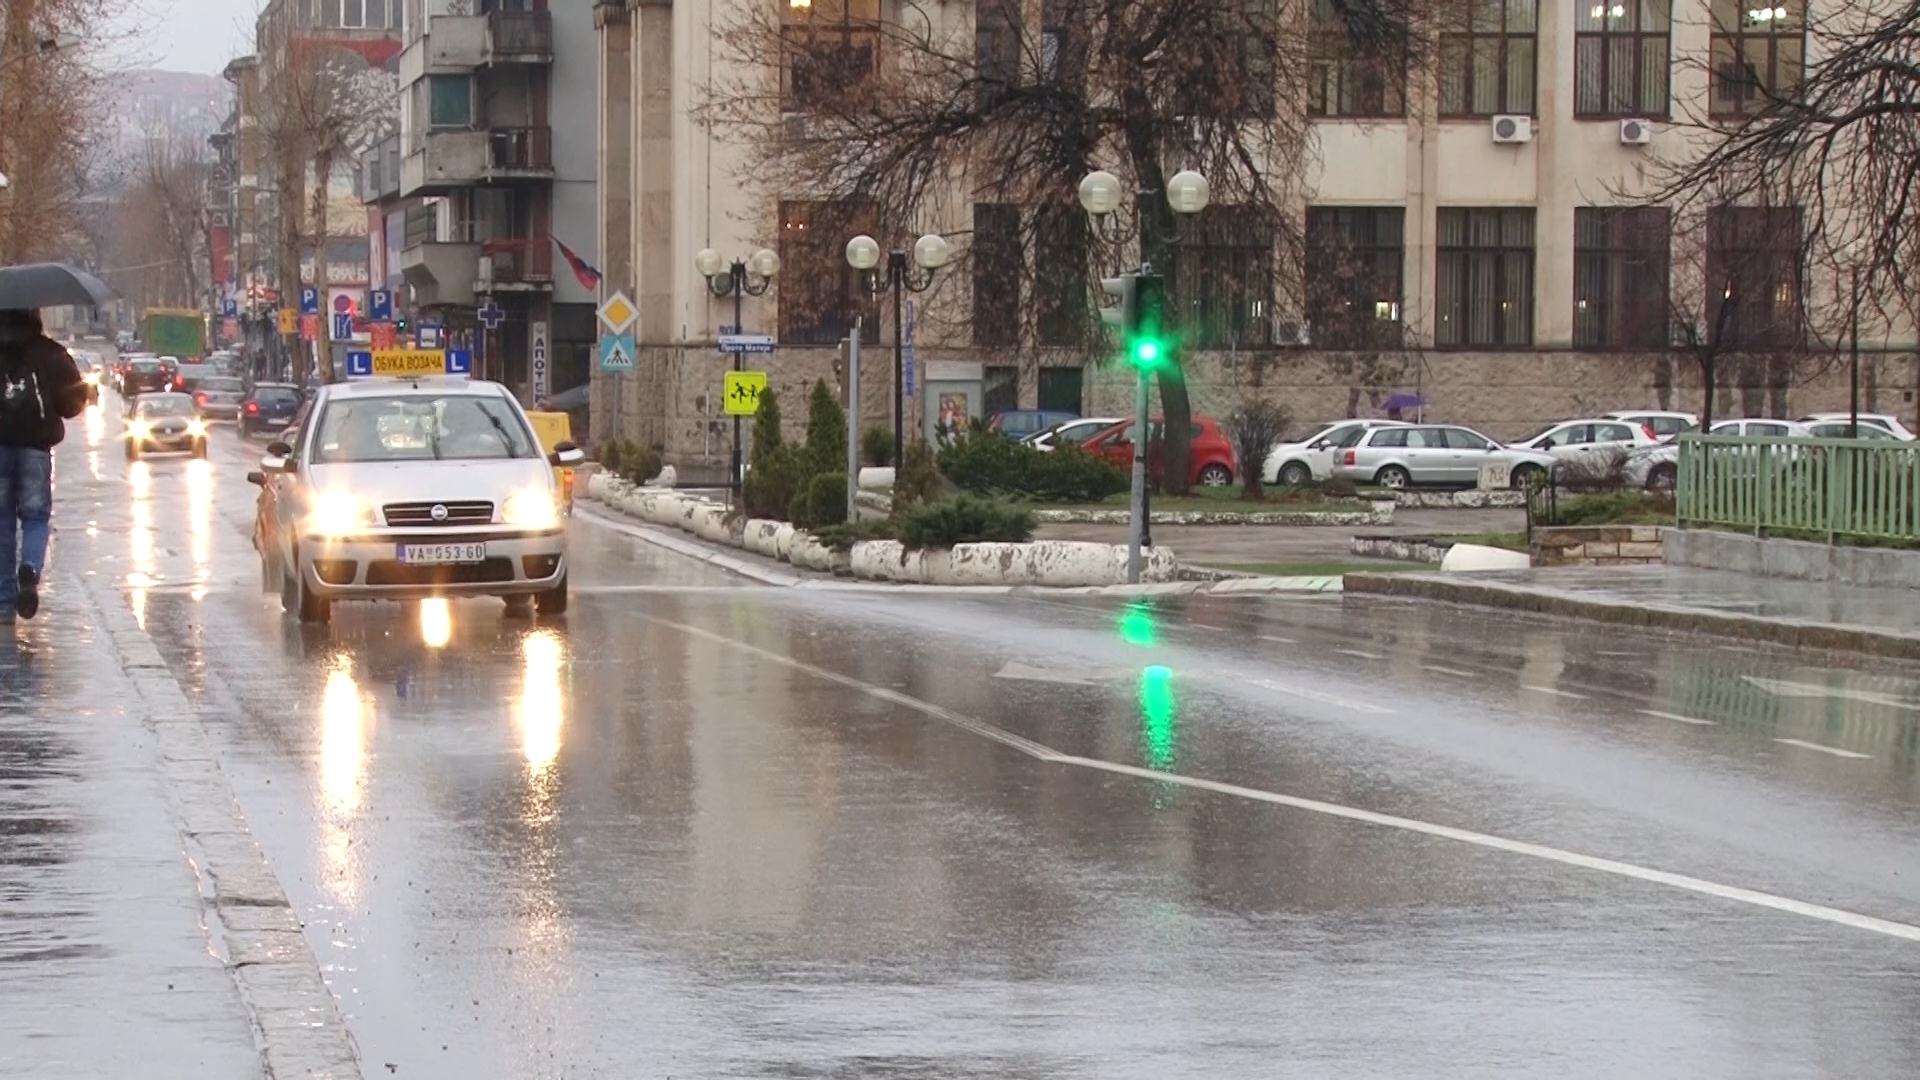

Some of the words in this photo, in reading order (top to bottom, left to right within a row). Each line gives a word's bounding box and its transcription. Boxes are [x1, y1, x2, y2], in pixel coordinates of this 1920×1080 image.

[304, 290, 314, 303] P
[374, 292, 386, 308] P
[226, 300, 234, 311] P
[353, 354, 366, 373] L
[374, 355, 404, 371] ОБУКА
[406, 355, 442, 371] ВОЗАЧА
[451, 352, 464, 371] L
[534, 337, 545, 403] АПОТЕК
[408, 547, 424, 560] VA
